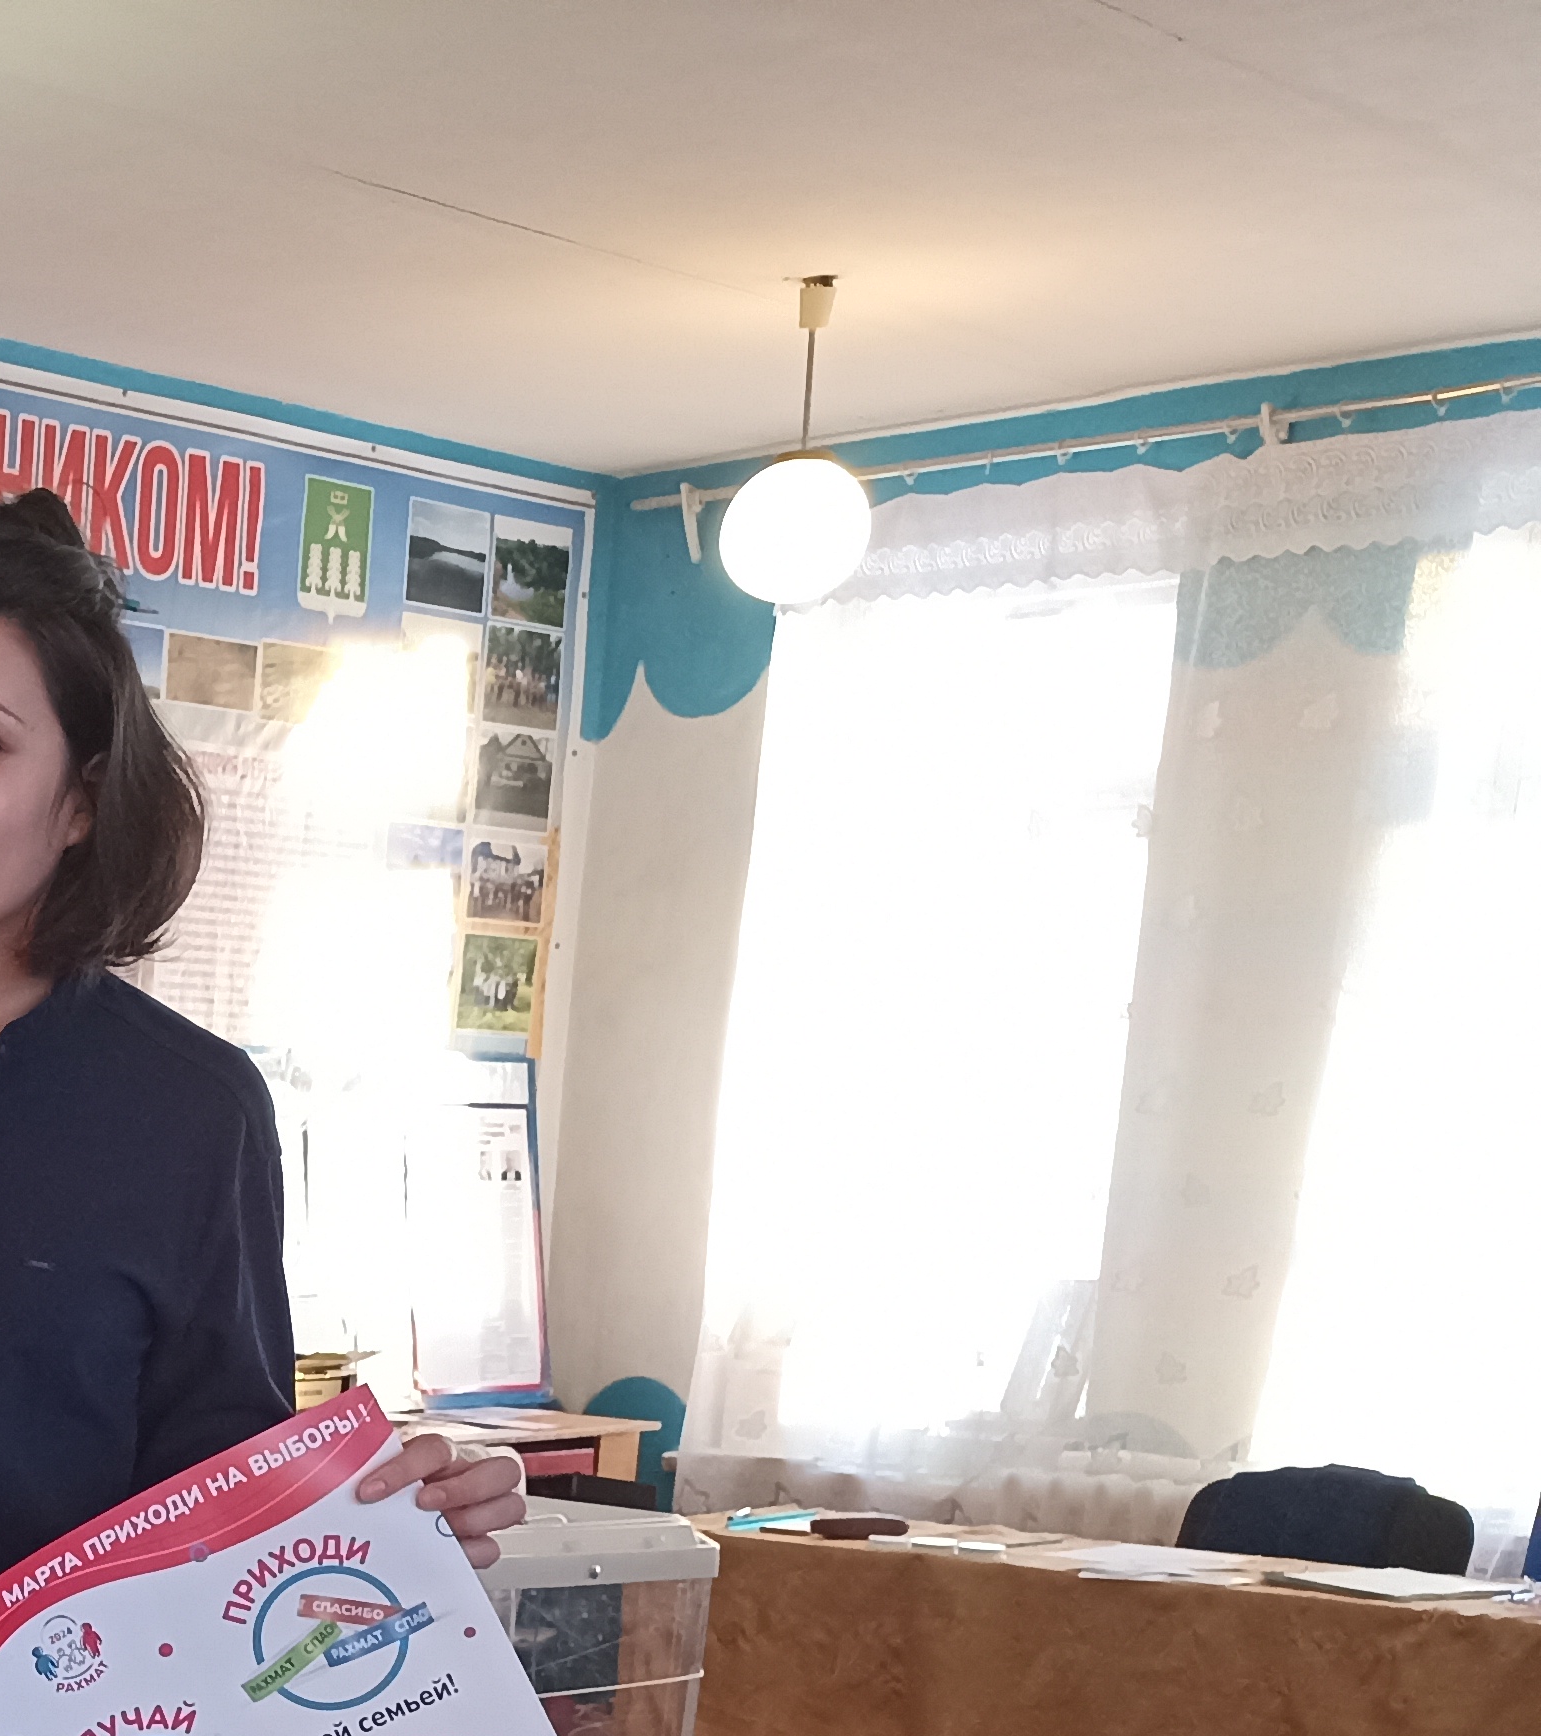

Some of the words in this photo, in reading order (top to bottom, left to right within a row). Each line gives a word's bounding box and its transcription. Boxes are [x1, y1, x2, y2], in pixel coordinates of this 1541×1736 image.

[2, 1552, 82, 1608] МАРТА
[83, 1485, 204, 1560] ПРИХОДИ
[206, 1467, 247, 1496] НА
[222, 1535, 371, 1625] ПРИХОДИ
[312, 1600, 385, 1621] СПАСИБО
[49, 1626, 73, 1645] 2024
[330, 1629, 383, 1660] РАХМАТ
[56, 1660, 109, 1693] РАХМАТ
[249, 1657, 296, 1695] РАХМАТ
[358, 1673, 459, 1733] семьей!
